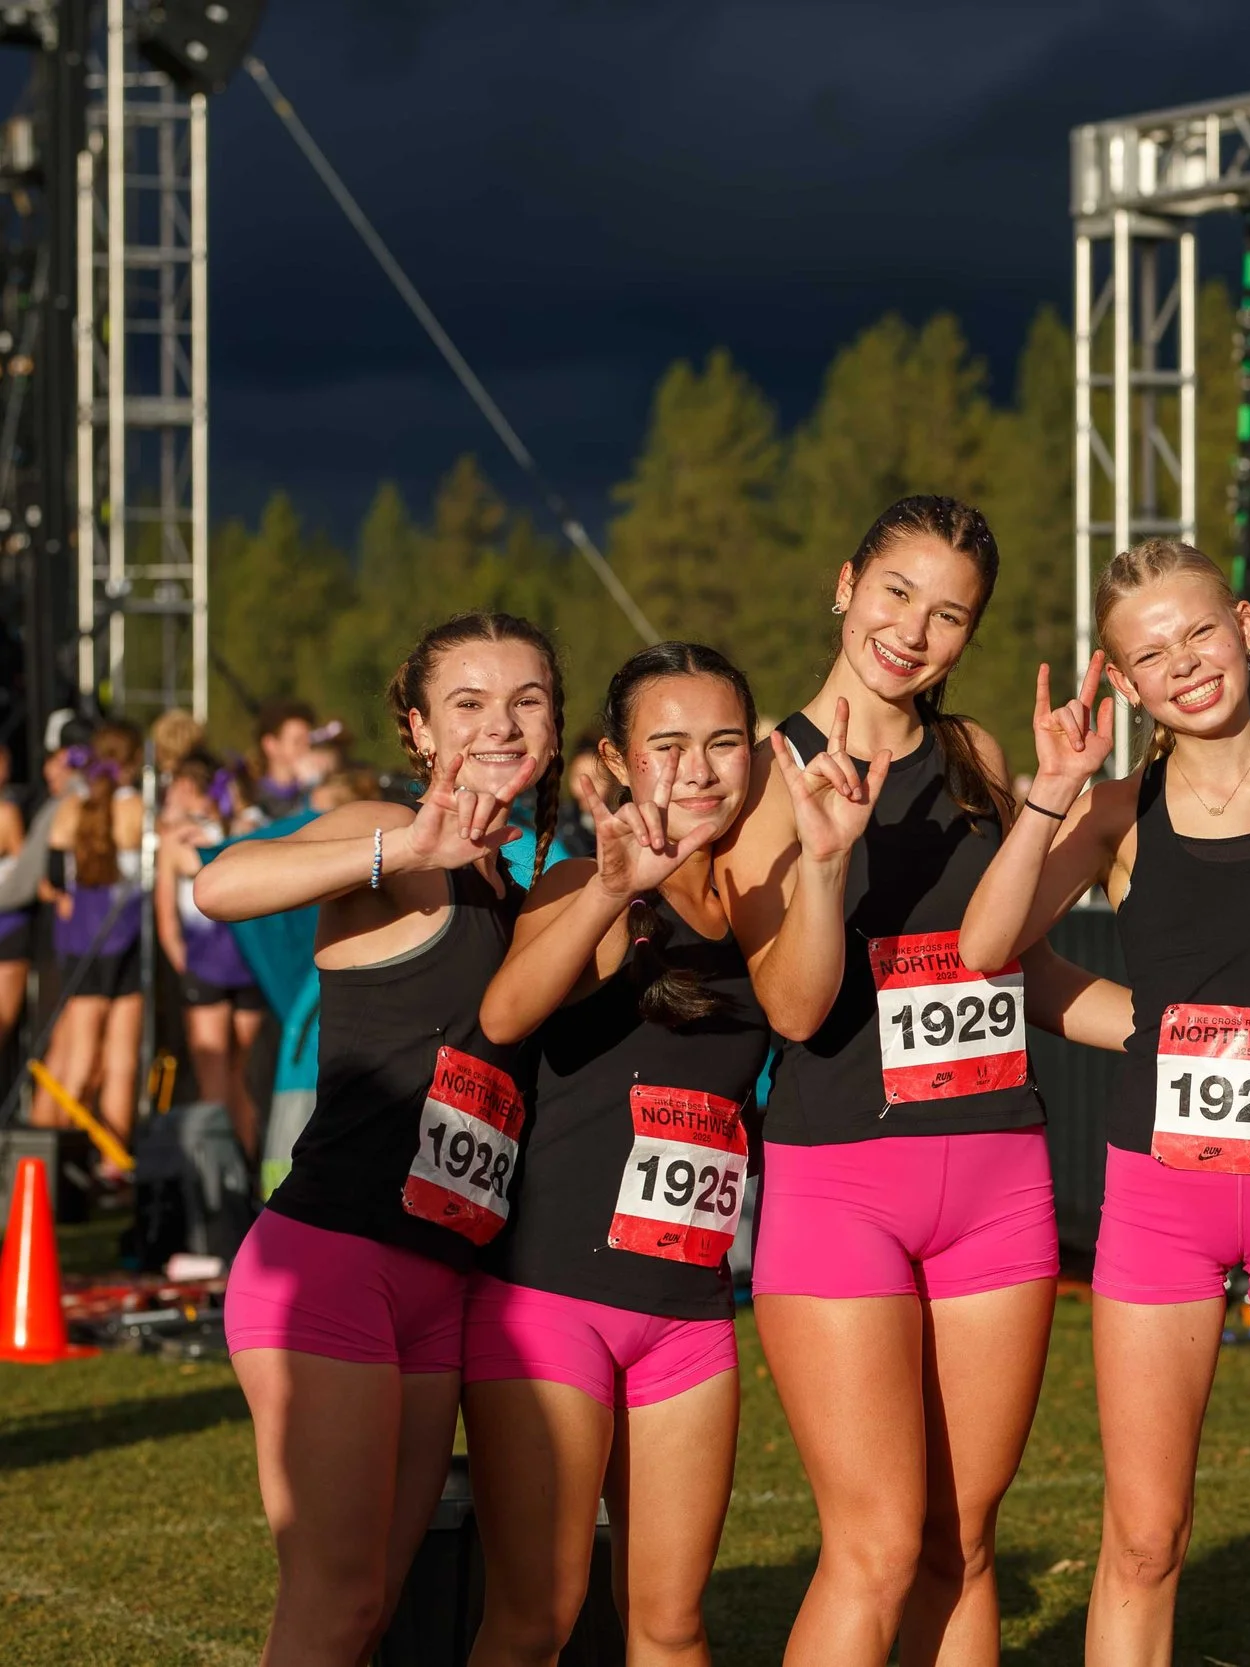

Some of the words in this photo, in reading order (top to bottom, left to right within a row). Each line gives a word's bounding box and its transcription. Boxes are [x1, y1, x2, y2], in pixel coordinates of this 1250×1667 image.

[891, 946, 912, 956] NIKE
[913, 943, 943, 953] CROSS
[879, 952, 966, 977] NORTHW
[936, 971, 958, 981] 2025
[891, 991, 1016, 1050] 1929
[1187, 1016, 1209, 1025] NIKE
[1211, 1017, 1242, 1026] CROSS
[935, 1071, 955, 1082] RUN
[441, 1069, 522, 1120] NORTHWEST
[654, 1098, 673, 1107] NIKE
[675, 1100, 703, 1111] CROSS
[641, 1106, 739, 1140] NORTHWEST
[692, 1131, 712, 1144] 2025
[1203, 1146, 1223, 1155] RUN
[427, 1122, 510, 1198] 1928
[637, 1155, 740, 1217] 1925
[662, 1232, 681, 1243] RUN
